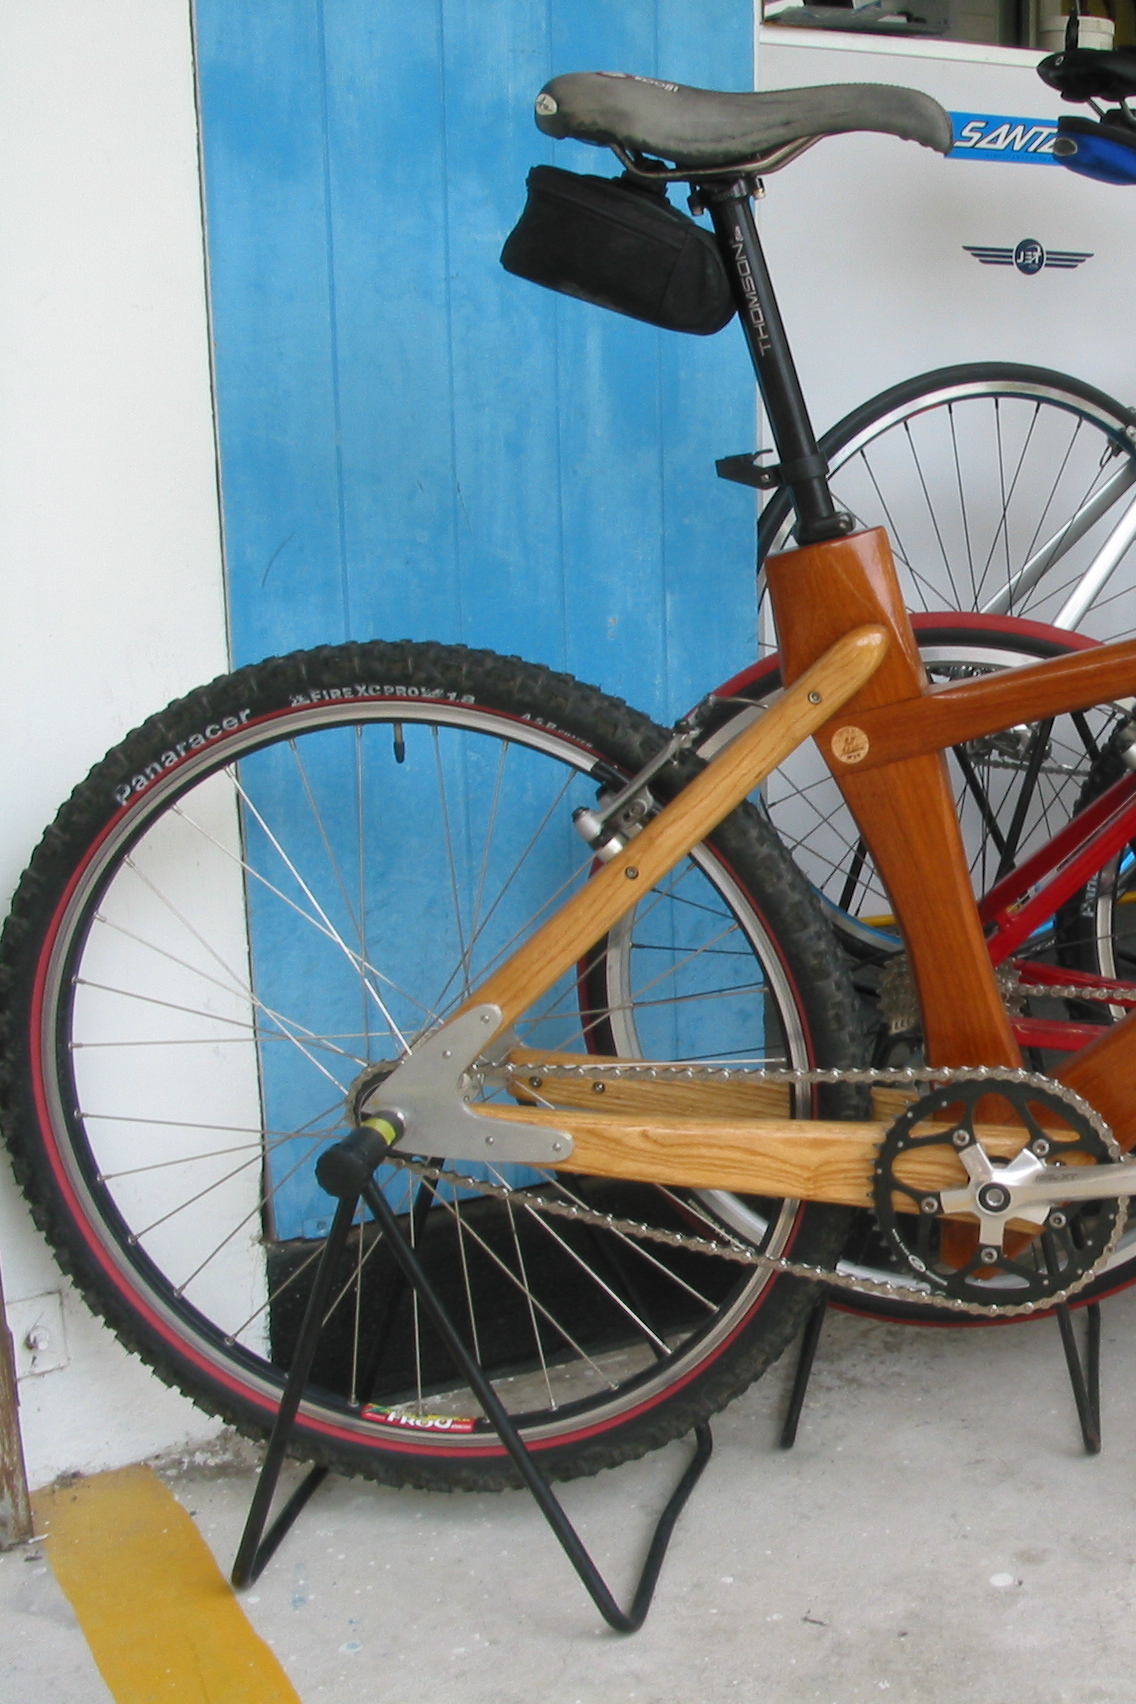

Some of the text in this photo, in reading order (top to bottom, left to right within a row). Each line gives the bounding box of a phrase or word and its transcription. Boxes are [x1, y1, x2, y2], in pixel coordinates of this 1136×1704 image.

[732, 243, 771, 356] THOMSON
[311, 686, 352, 704] FIRE
[356, 683, 381, 697] XC
[384, 684, 419, 698] PRO
[113, 708, 251, 806] Panaracer
